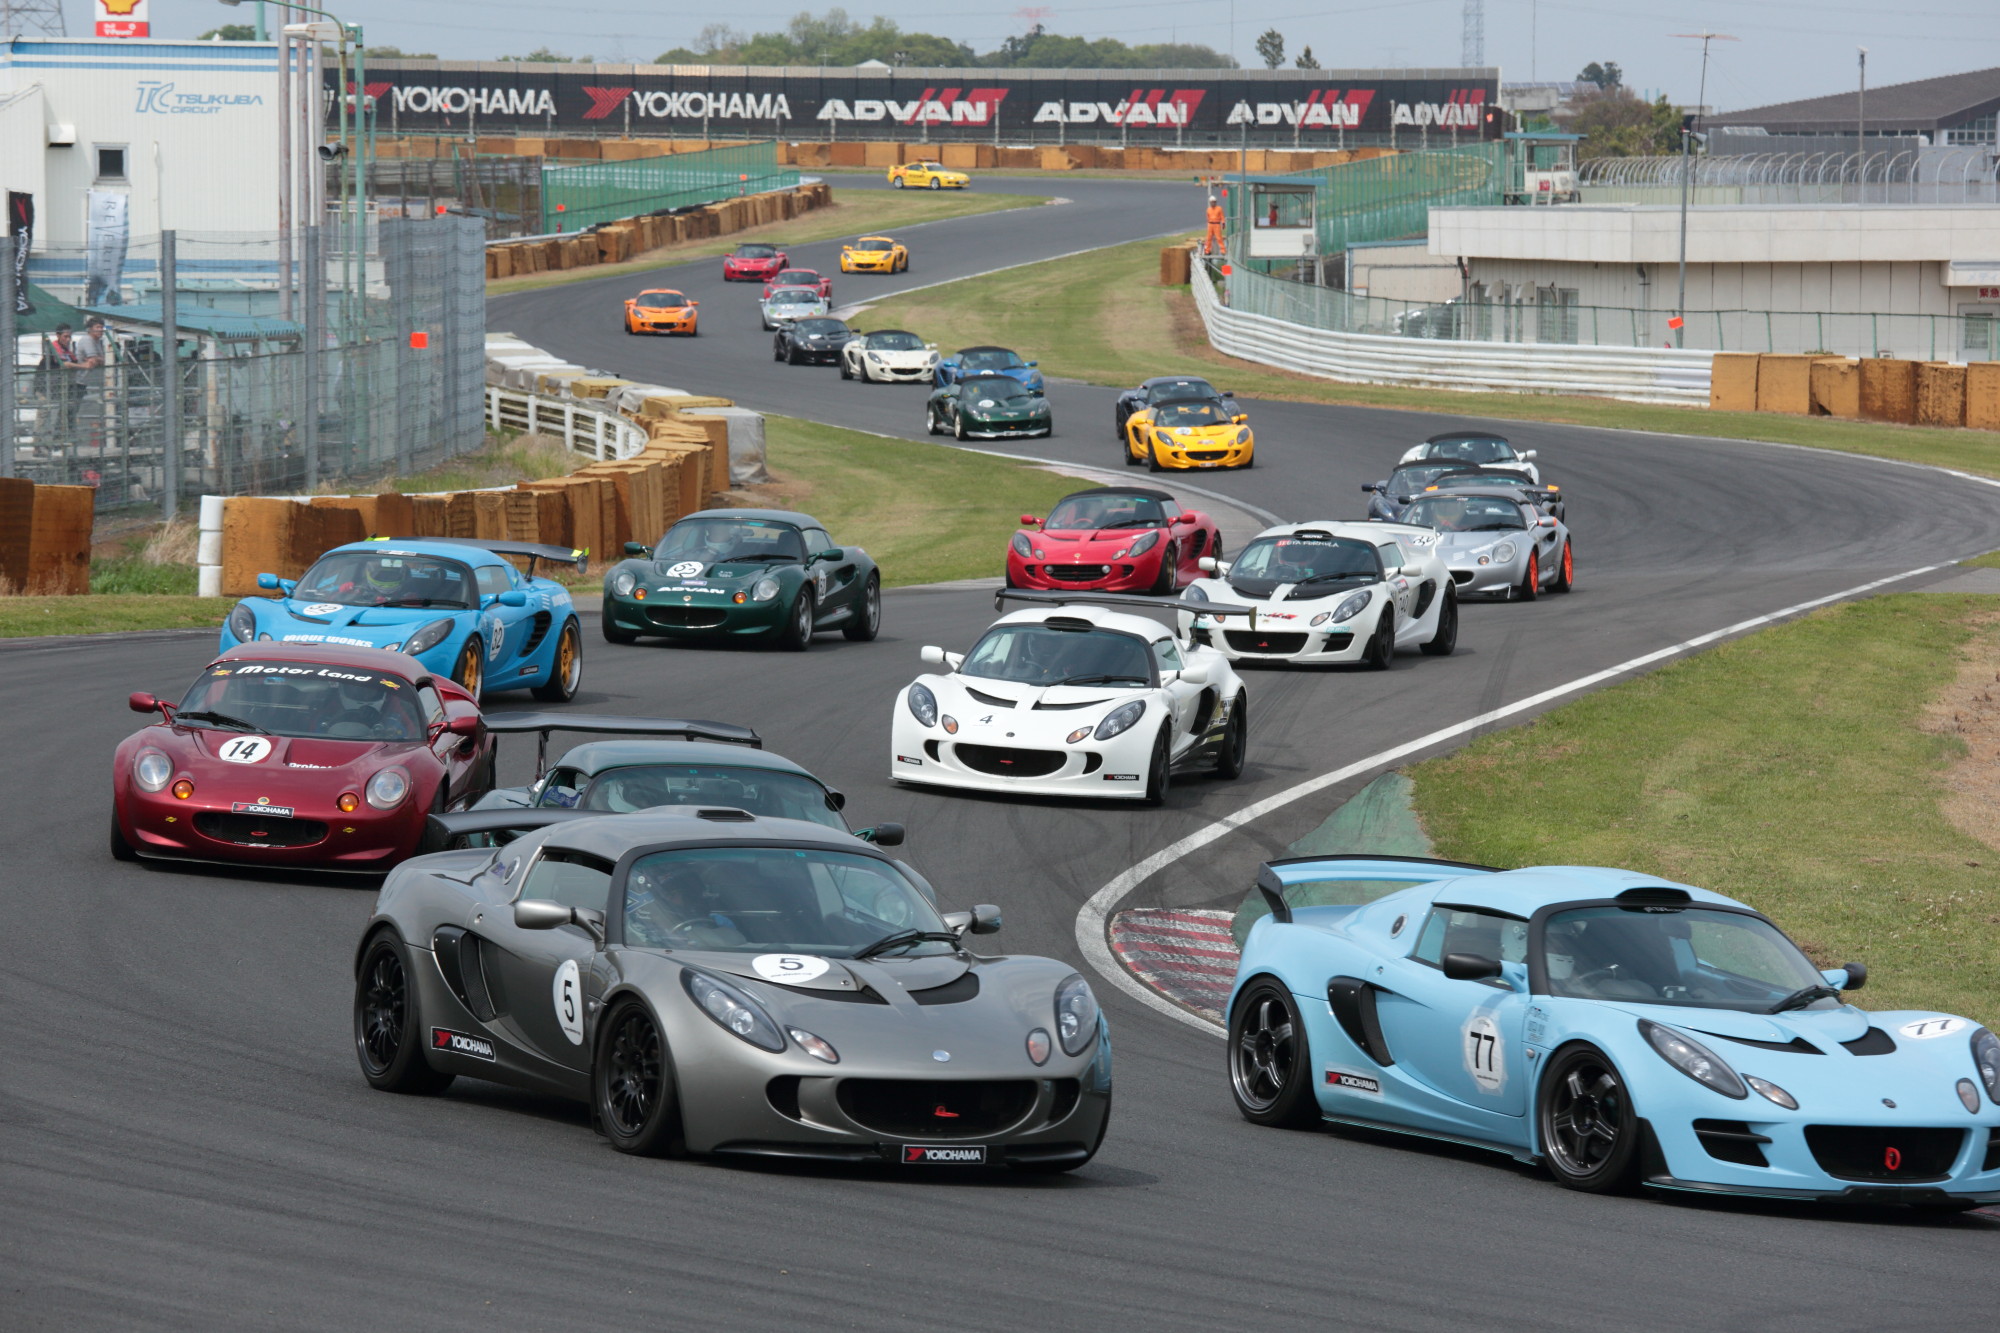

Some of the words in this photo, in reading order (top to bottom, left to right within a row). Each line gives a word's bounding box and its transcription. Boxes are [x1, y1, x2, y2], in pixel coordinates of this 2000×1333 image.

[175, 94, 263, 105] TSUKUBA
[391, 86, 557, 116] YOKOHAMA
[632, 91, 792, 120] YOKOHAMA
[170, 106, 222, 114] CIRCUIT
[816, 98, 988, 122] ADVAN
[1033, 101, 1188, 124] ADVAN
[1226, 102, 1359, 126] ADVAN
[1394, 103, 1479, 126] ADVAN
[673, 562, 697, 578] 52
[657, 586, 725, 595] ADVAN
[308, 603, 339, 613] 32
[325, 635, 374, 648] WORKS
[491, 627, 503, 651] 32
[235, 665, 314, 675] Motor
[317, 668, 372, 682] Land
[980, 714, 993, 724] 4
[228, 740, 259, 759] 14
[248, 805, 290, 815] YOKOHAMA
[779, 957, 804, 971] 5
[563, 979, 575, 1023] 5
[1906, 1019, 1953, 1036] 77
[450, 1034, 493, 1056] YOKOHAMA
[1470, 1031, 1495, 1072] 77
[1340, 1075, 1378, 1091] YOKOHAMA
[924, 1149, 982, 1161] YOKOHAMA
